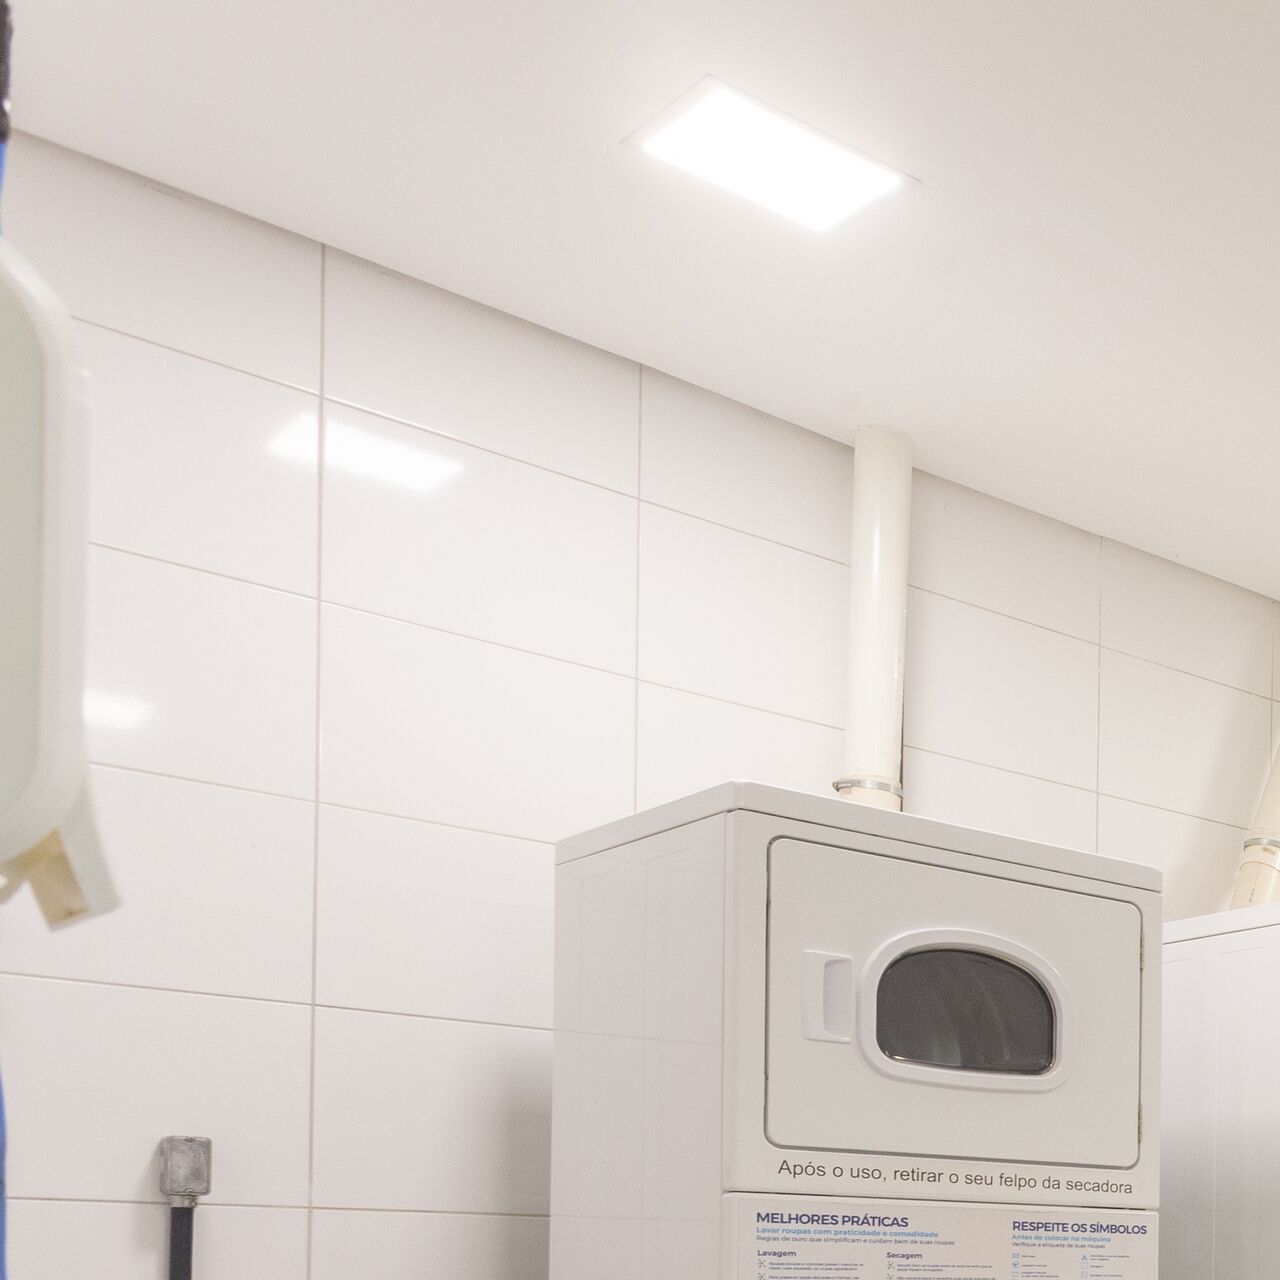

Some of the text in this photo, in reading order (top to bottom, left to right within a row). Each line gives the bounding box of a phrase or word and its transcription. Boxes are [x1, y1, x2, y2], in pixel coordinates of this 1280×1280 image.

[777, 1160, 1133, 1194] Após o uso, retirar o seu felpo da secadora
[756, 1212, 909, 1227] MELHORES PRÁTICAS
[782, 1228, 811, 1236] roupas
[1012, 1221, 1147, 1234] RESPEITE OS SÍMBOLOS
[886, 1252, 922, 1260] Secagem
